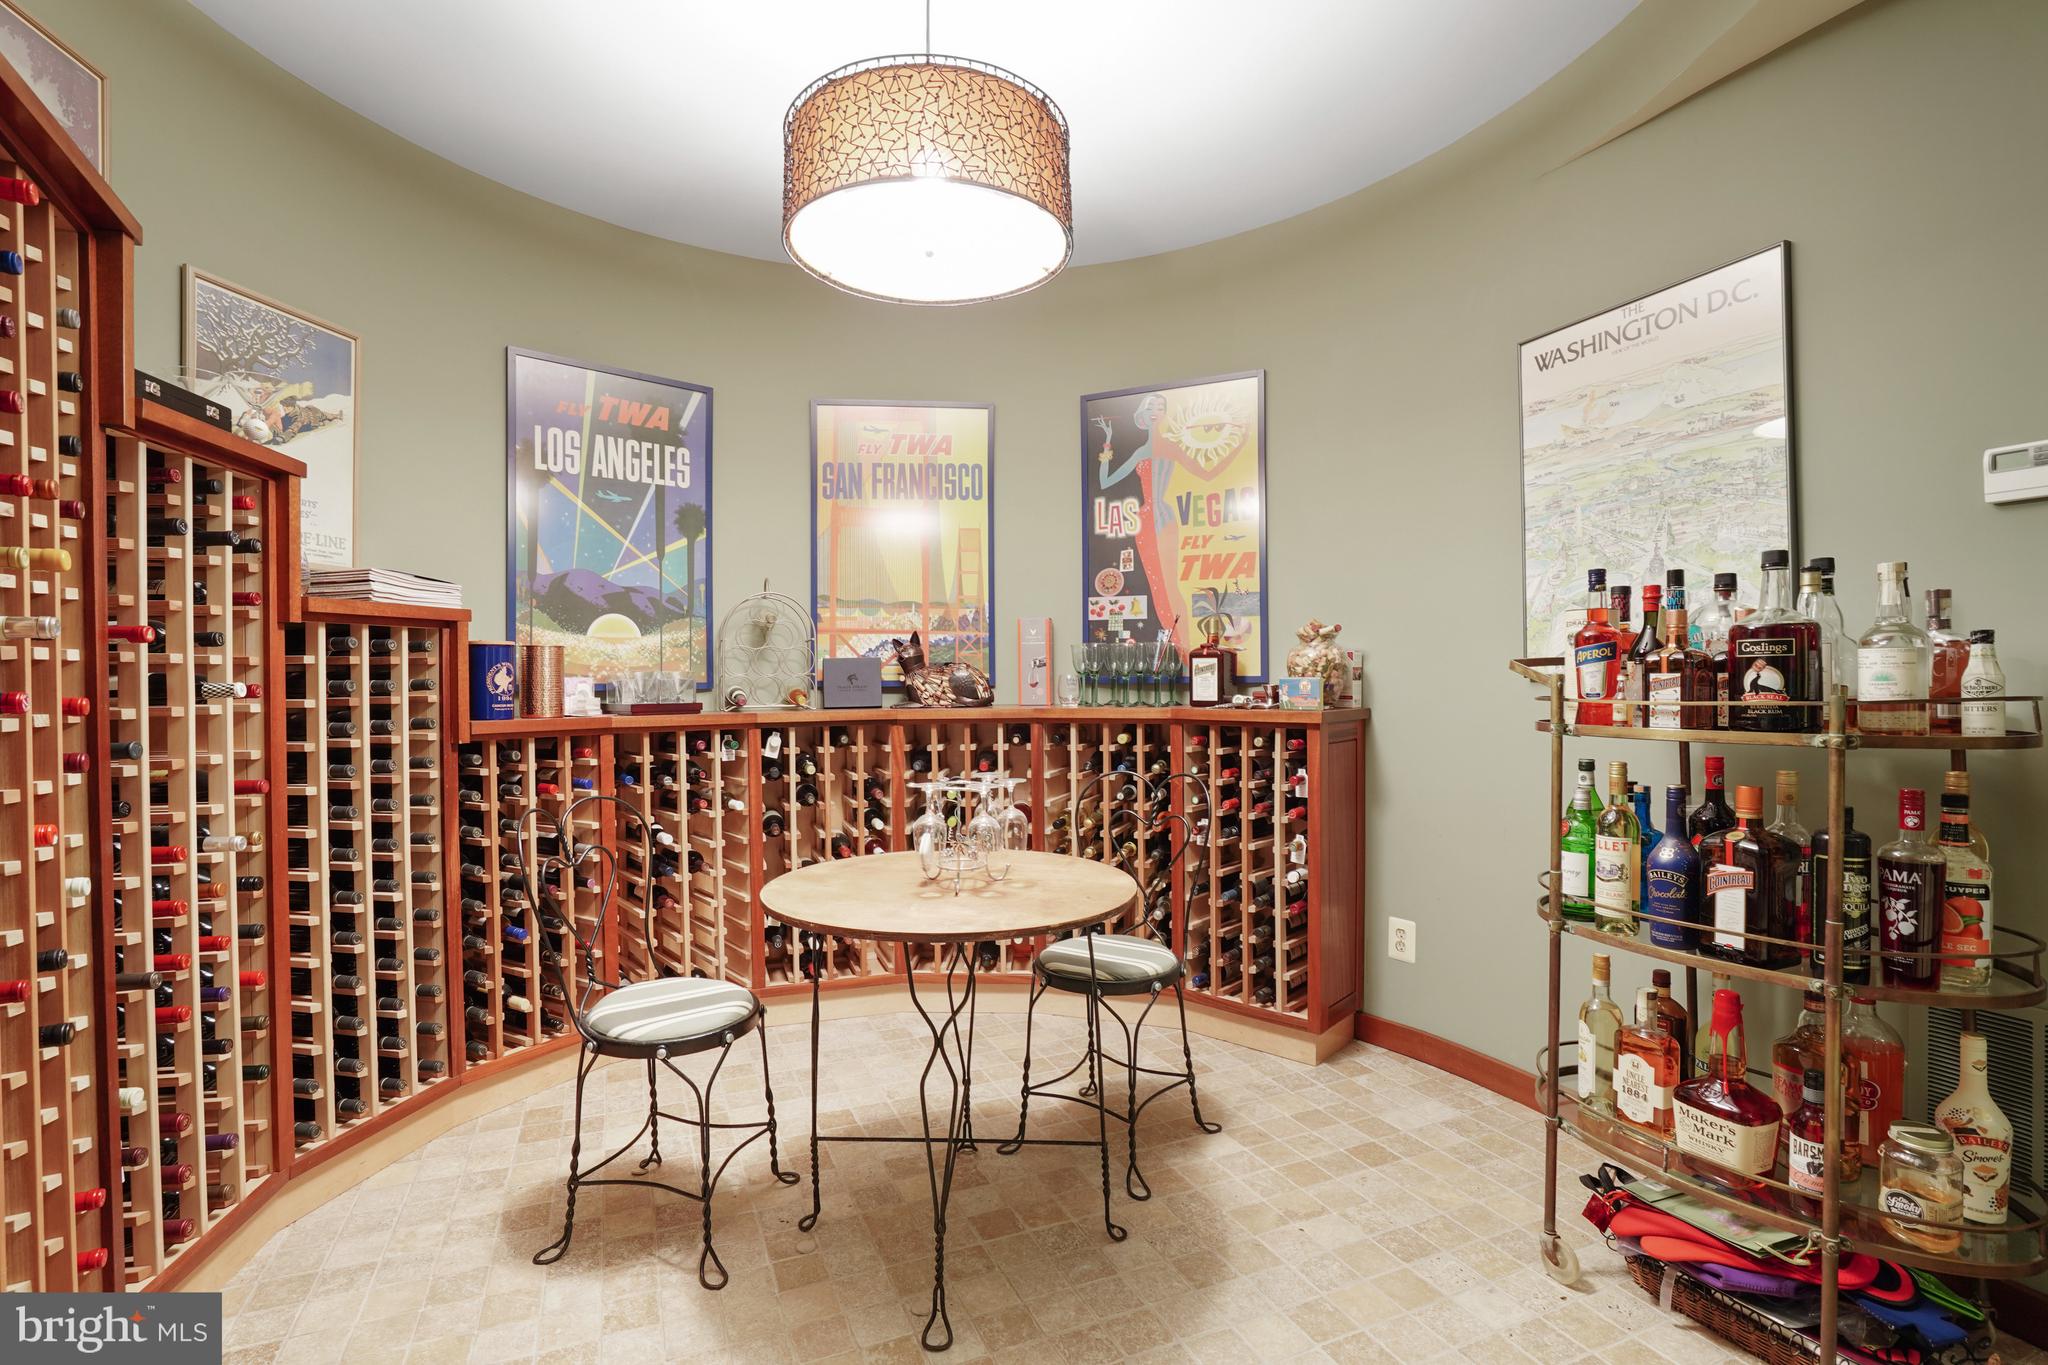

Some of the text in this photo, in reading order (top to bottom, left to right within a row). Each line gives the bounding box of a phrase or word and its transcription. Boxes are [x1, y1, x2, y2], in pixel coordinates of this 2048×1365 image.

[1621, 301, 1645, 319] THE
[1534, 278, 1759, 373] WASHINGTON D.C.
[556, 395, 671, 432] FLY TWA
[857, 433, 953, 456] FLY TWA
[534, 425, 691, 489] LOS ANGELES
[822, 461, 983, 501] SAN FRANCISCO
[1096, 498, 1141, 537] LAS
[1180, 534, 1214, 550] FLY
[1179, 551, 1257, 581] TWA
[1576, 647, 1613, 664] APEROL
[1741, 642, 1788, 654] Goslings
[1597, 840, 1630, 852] LLET
[1649, 870, 1685, 884] BAILEYS
[1709, 874, 1751, 889] COINTREAU
[1879, 866, 1922, 885] PAMA
[1957, 944, 1977, 952] SEC
[1626, 1069, 1645, 1082] UNCLE
[1621, 1076, 1649, 1094] NEAREST
[1621, 1085, 1648, 1102] 1884
[1678, 1105, 1736, 1136] Maker's
[1687, 1134, 1726, 1153] WHISKY
[1692, 1123, 1736, 1149] Mark
[1958, 1135, 2009, 1151] BAILEYS
[1887, 1195, 1922, 1214] Smoky
